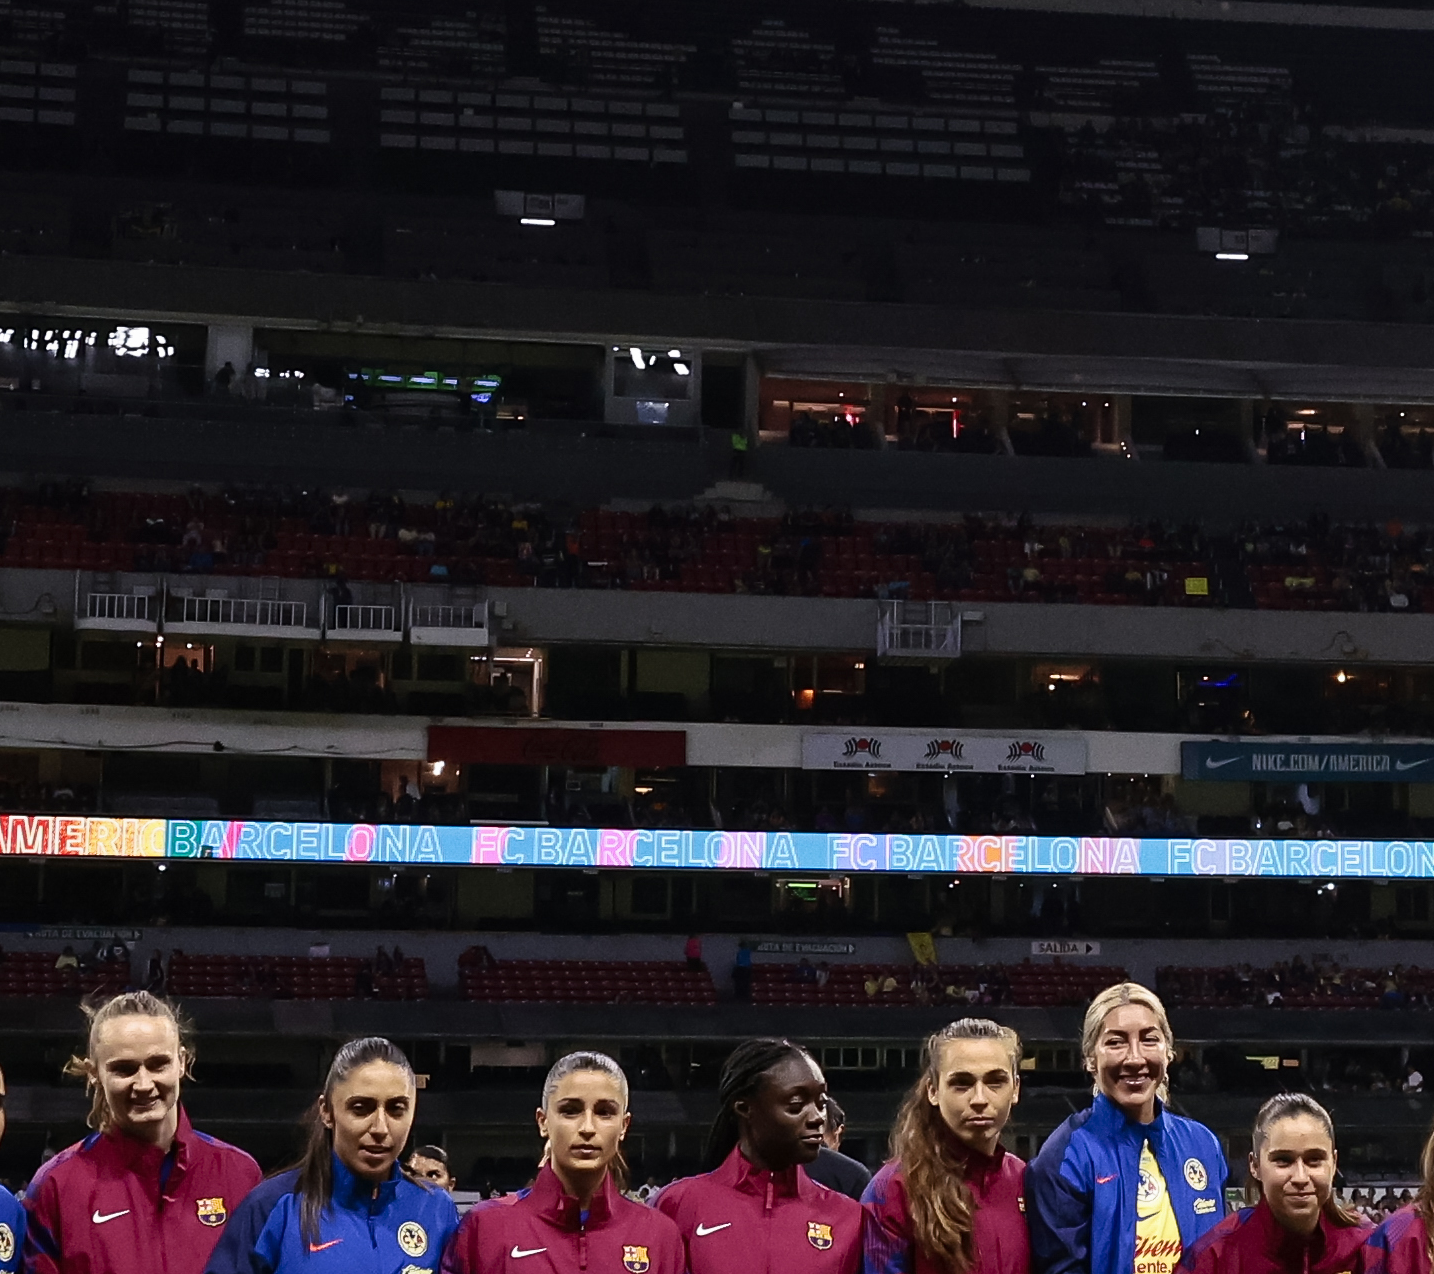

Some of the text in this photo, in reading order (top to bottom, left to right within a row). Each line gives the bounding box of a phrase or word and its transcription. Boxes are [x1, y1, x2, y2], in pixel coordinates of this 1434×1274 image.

[1252, 753, 1390, 772] NIKE.COM/AMERICA
[168, 820, 442, 863] BARCELONA
[473, 825, 526, 865] FC
[539, 828, 800, 869] BARCELONA
[827, 832, 879, 870] FC
[884, 833, 1142, 875] BARCELONA
[1167, 838, 1218, 875] FC
[1039, 942, 1078, 954] SALIDA
